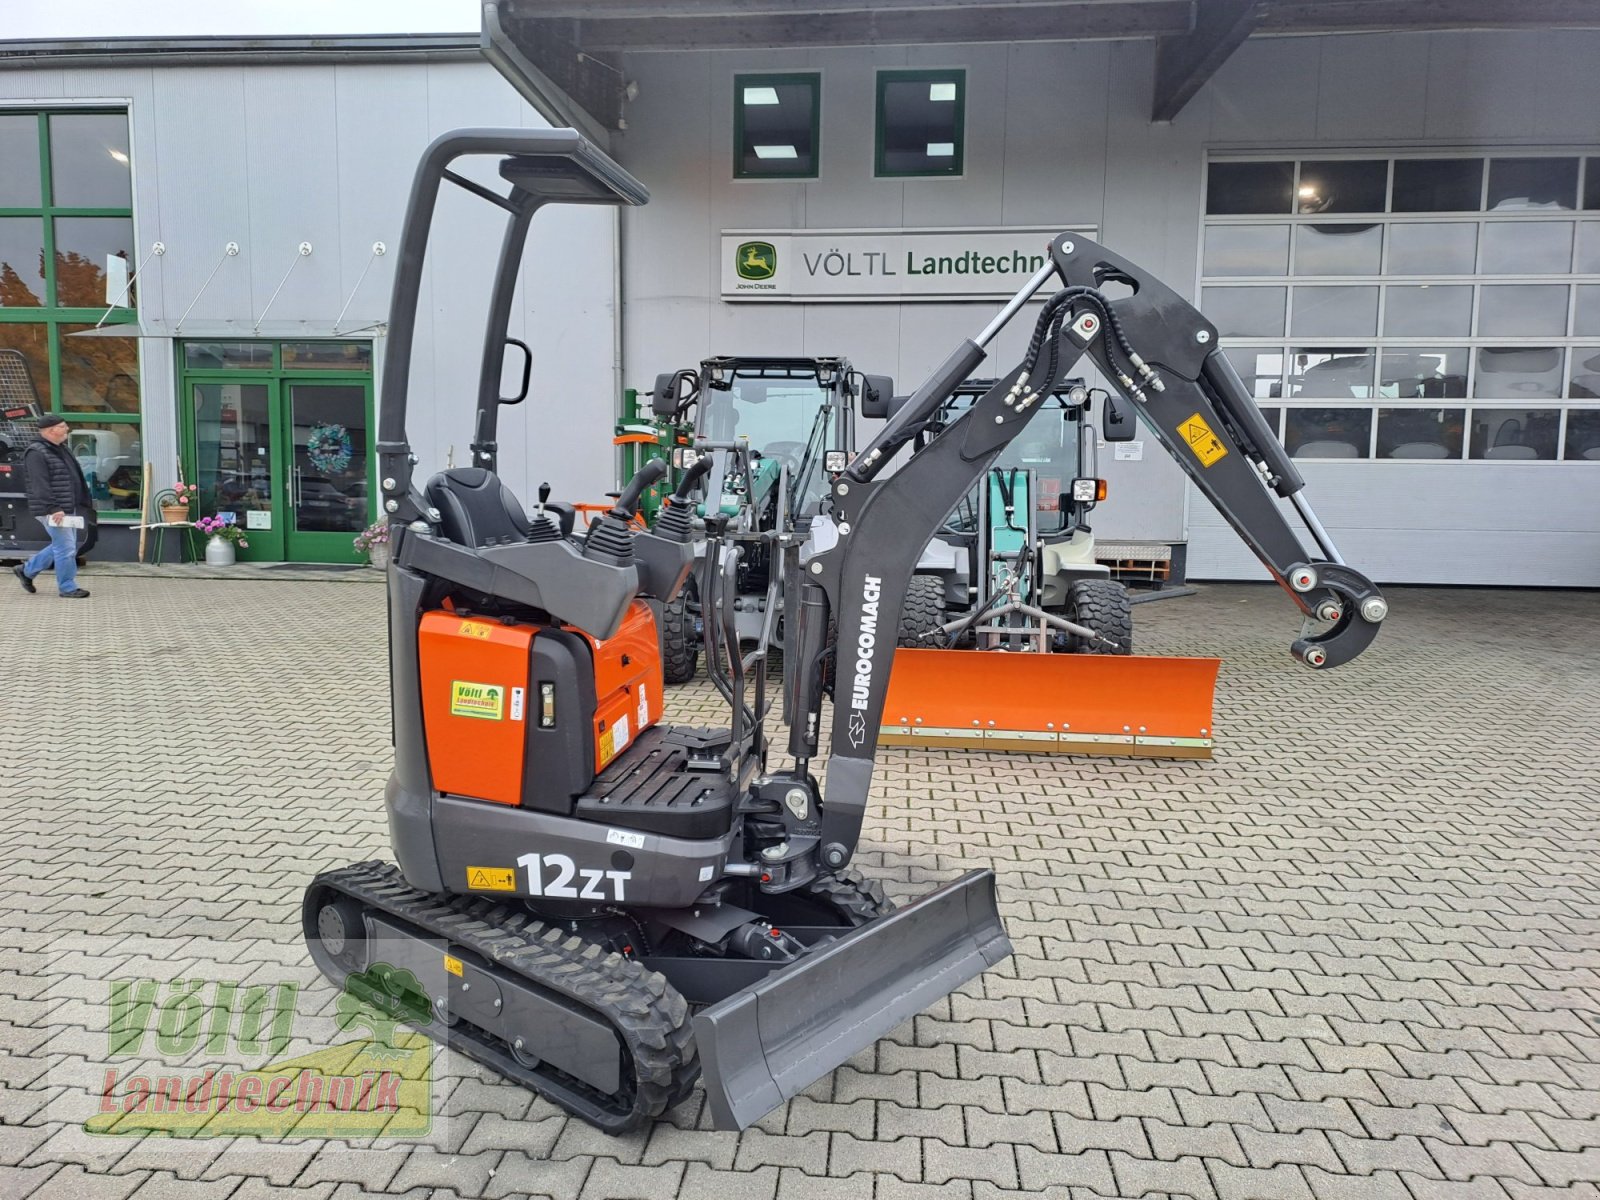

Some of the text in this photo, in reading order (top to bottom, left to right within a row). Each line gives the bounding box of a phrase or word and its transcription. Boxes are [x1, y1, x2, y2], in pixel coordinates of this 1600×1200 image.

[803, 248, 897, 276] VÖLTL
[851, 576, 882, 710] EUROCOMACH
[458, 686, 483, 698] Völtl
